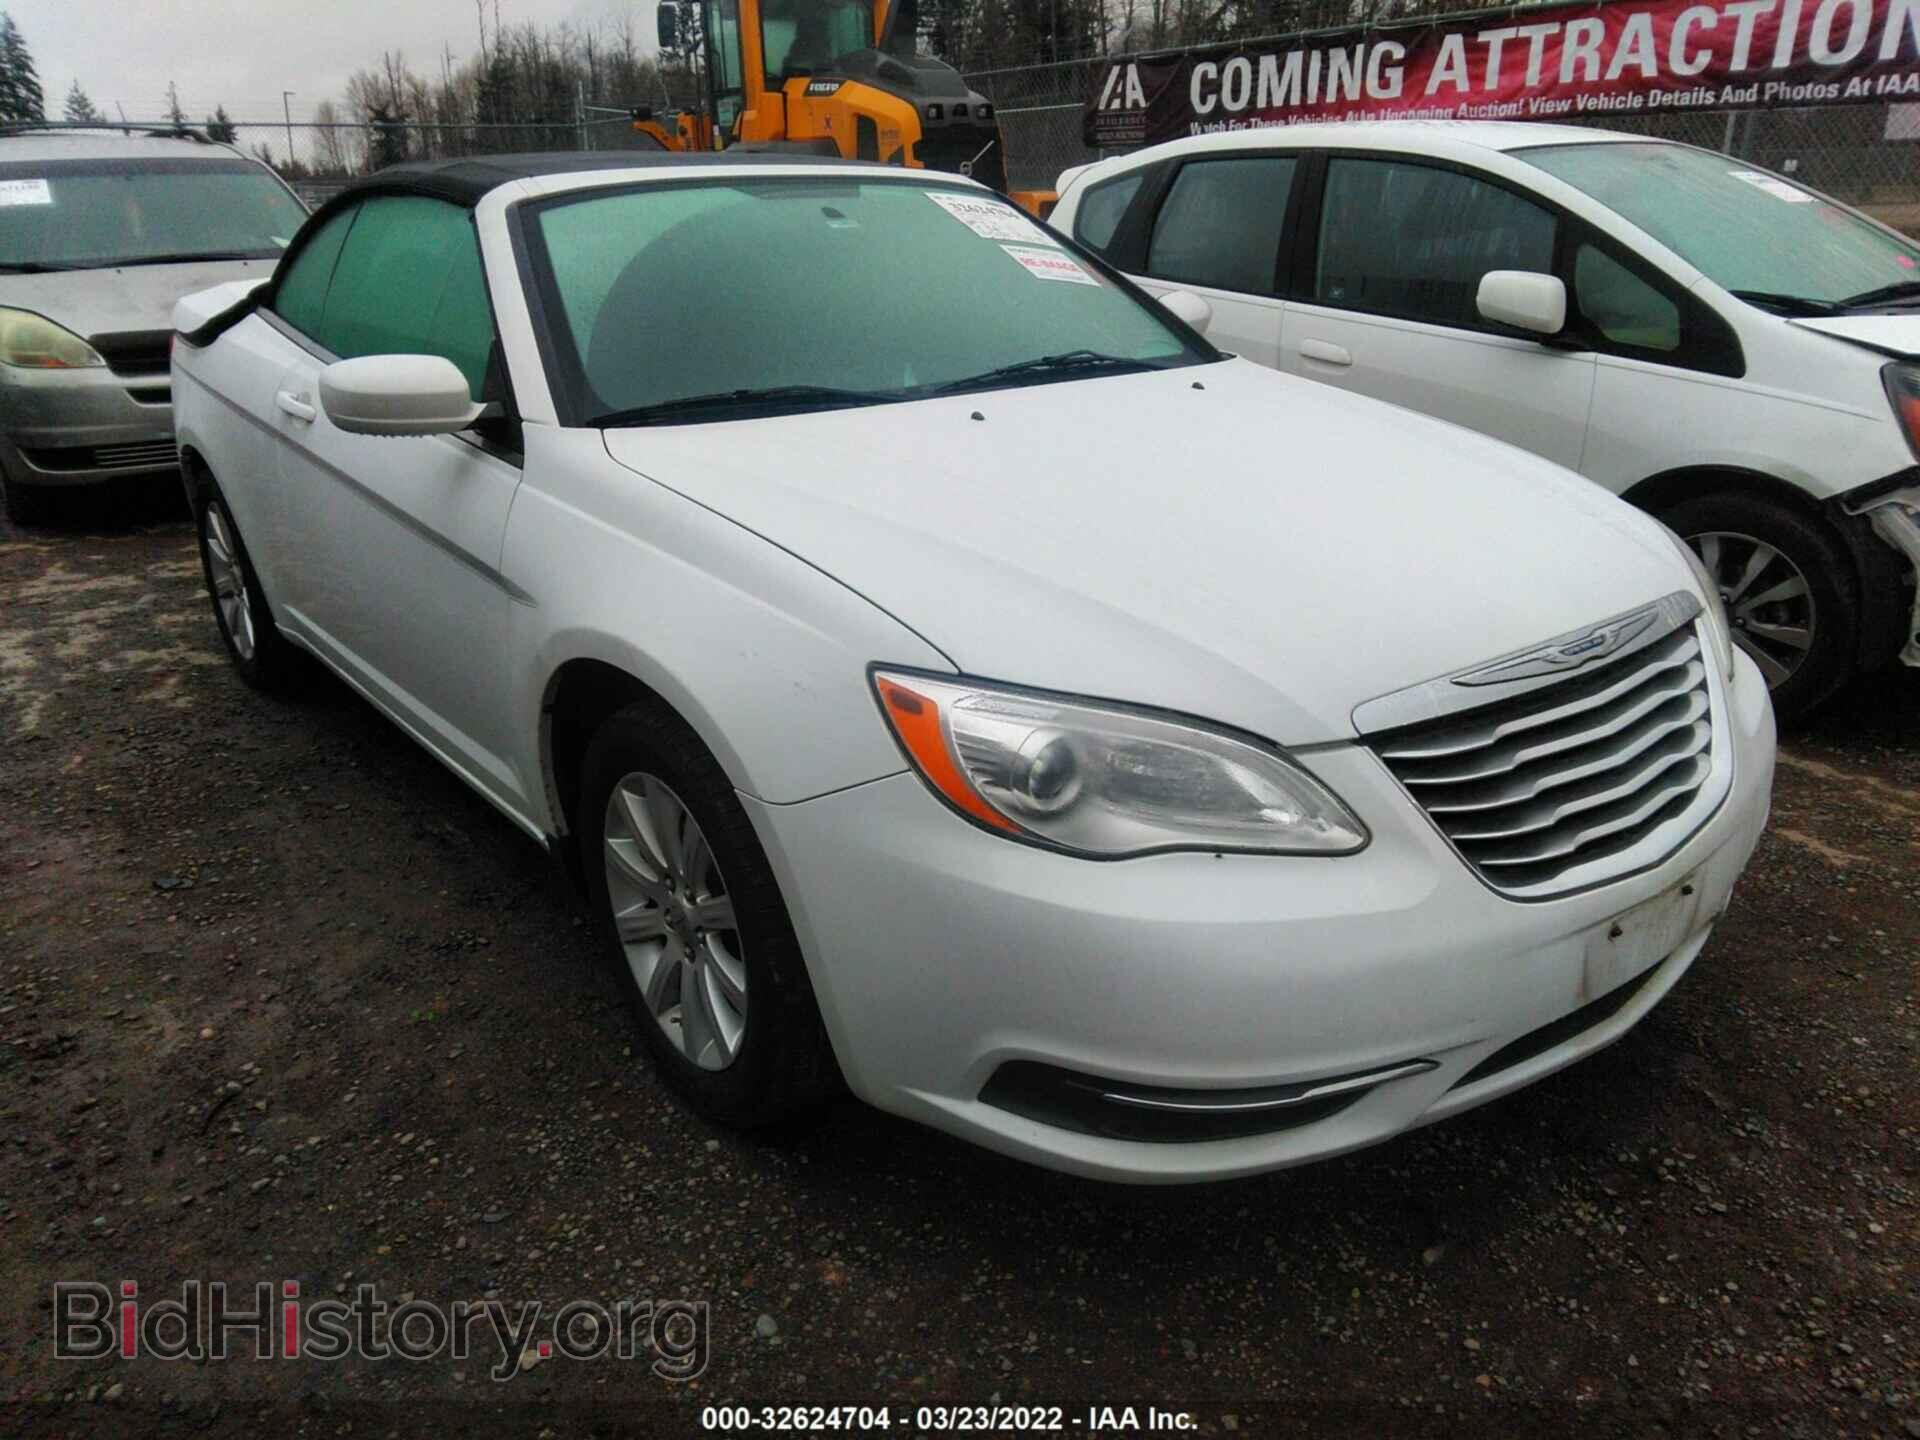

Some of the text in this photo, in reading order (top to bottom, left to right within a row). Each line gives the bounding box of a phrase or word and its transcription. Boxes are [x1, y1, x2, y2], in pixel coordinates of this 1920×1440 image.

[1190, 41, 1405, 115] COMING
[1456, 99, 1523, 119] Auction!
[1529, 97, 1572, 114] View
[1576, 91, 1643, 111] Vehicle
[1648, 86, 1715, 107] Details
[1719, 83, 1758, 104] And
[1764, 81, 1841, 102] Photos
[1844, 76, 1872, 97] At
